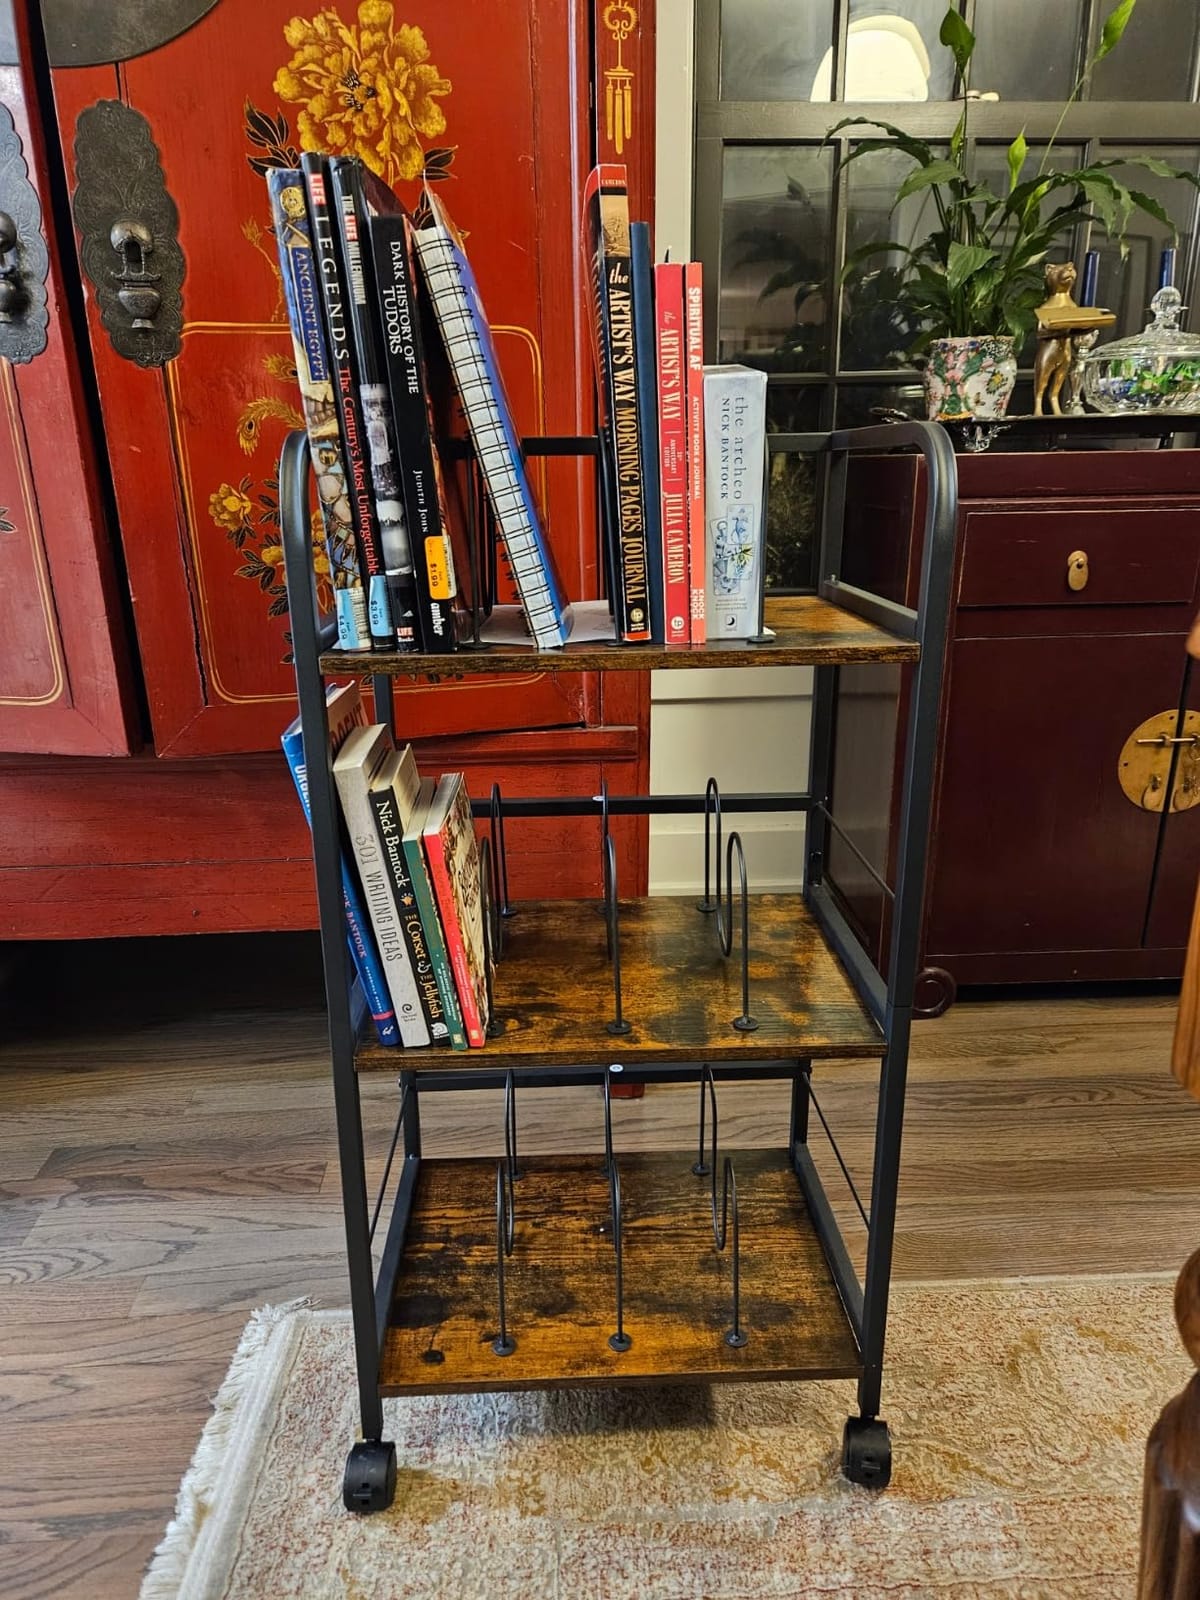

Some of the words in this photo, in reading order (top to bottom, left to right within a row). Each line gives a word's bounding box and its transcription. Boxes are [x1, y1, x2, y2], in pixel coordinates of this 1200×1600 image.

[309, 172, 327, 206] LIFE
[341, 195, 355, 214] THE
[344, 214, 358, 240] LIFE
[347, 241, 366, 305] MILLENNIUM
[390, 241, 405, 280] DARK
[609, 262, 629, 284] the
[315, 215, 349, 360] LEGENDS
[296, 251, 317, 327] ANCIENT
[307, 329, 326, 379] EGYPT
[383, 286, 402, 355] TUDORS
[396, 284, 412, 342] HISTORY
[609, 288, 633, 364] ARTIST'S
[664, 311, 677, 325] the
[689, 287, 700, 352] SPIRITUAL
[403, 345, 416, 364] OF
[660, 328, 680, 388] ARTIST'S
[690, 354, 701, 371] AF
[338, 366, 352, 393] The
[406, 366, 419, 394] THE
[614, 368, 636, 403] WAY
[662, 391, 681, 420] WAY
[721, 398, 730, 431] NICK
[735, 397, 748, 427] the
[343, 397, 361, 457] Century's
[616, 407, 639, 482] MORNING
[352, 460, 366, 490] Most
[721, 438, 730, 499] BANTOCK
[734, 437, 747, 499] archeo
[413, 470, 425, 505] JUDITH
[418, 508, 429, 533] JOHN
[620, 485, 642, 533] PAGES
[662, 492, 683, 526] JULIA
[355, 494, 379, 575] Unforgettable
[622, 536, 645, 604] JOURNAL
[666, 529, 685, 584] CAMERON
[430, 563, 439, 588] $1.99
[371, 599, 379, 626] $3.99
[430, 602, 446, 636] amber
[376, 800, 397, 834] Nick
[355, 834, 379, 864] 301
[385, 834, 410, 888] Bantock
[365, 870, 393, 924] WRITING
[345, 912, 367, 958] BANTOCK
[380, 927, 403, 962] IDEAS
[406, 920, 427, 960] Corset
[417, 959, 432, 974] &
[420, 980, 443, 1019] Jellyfish
